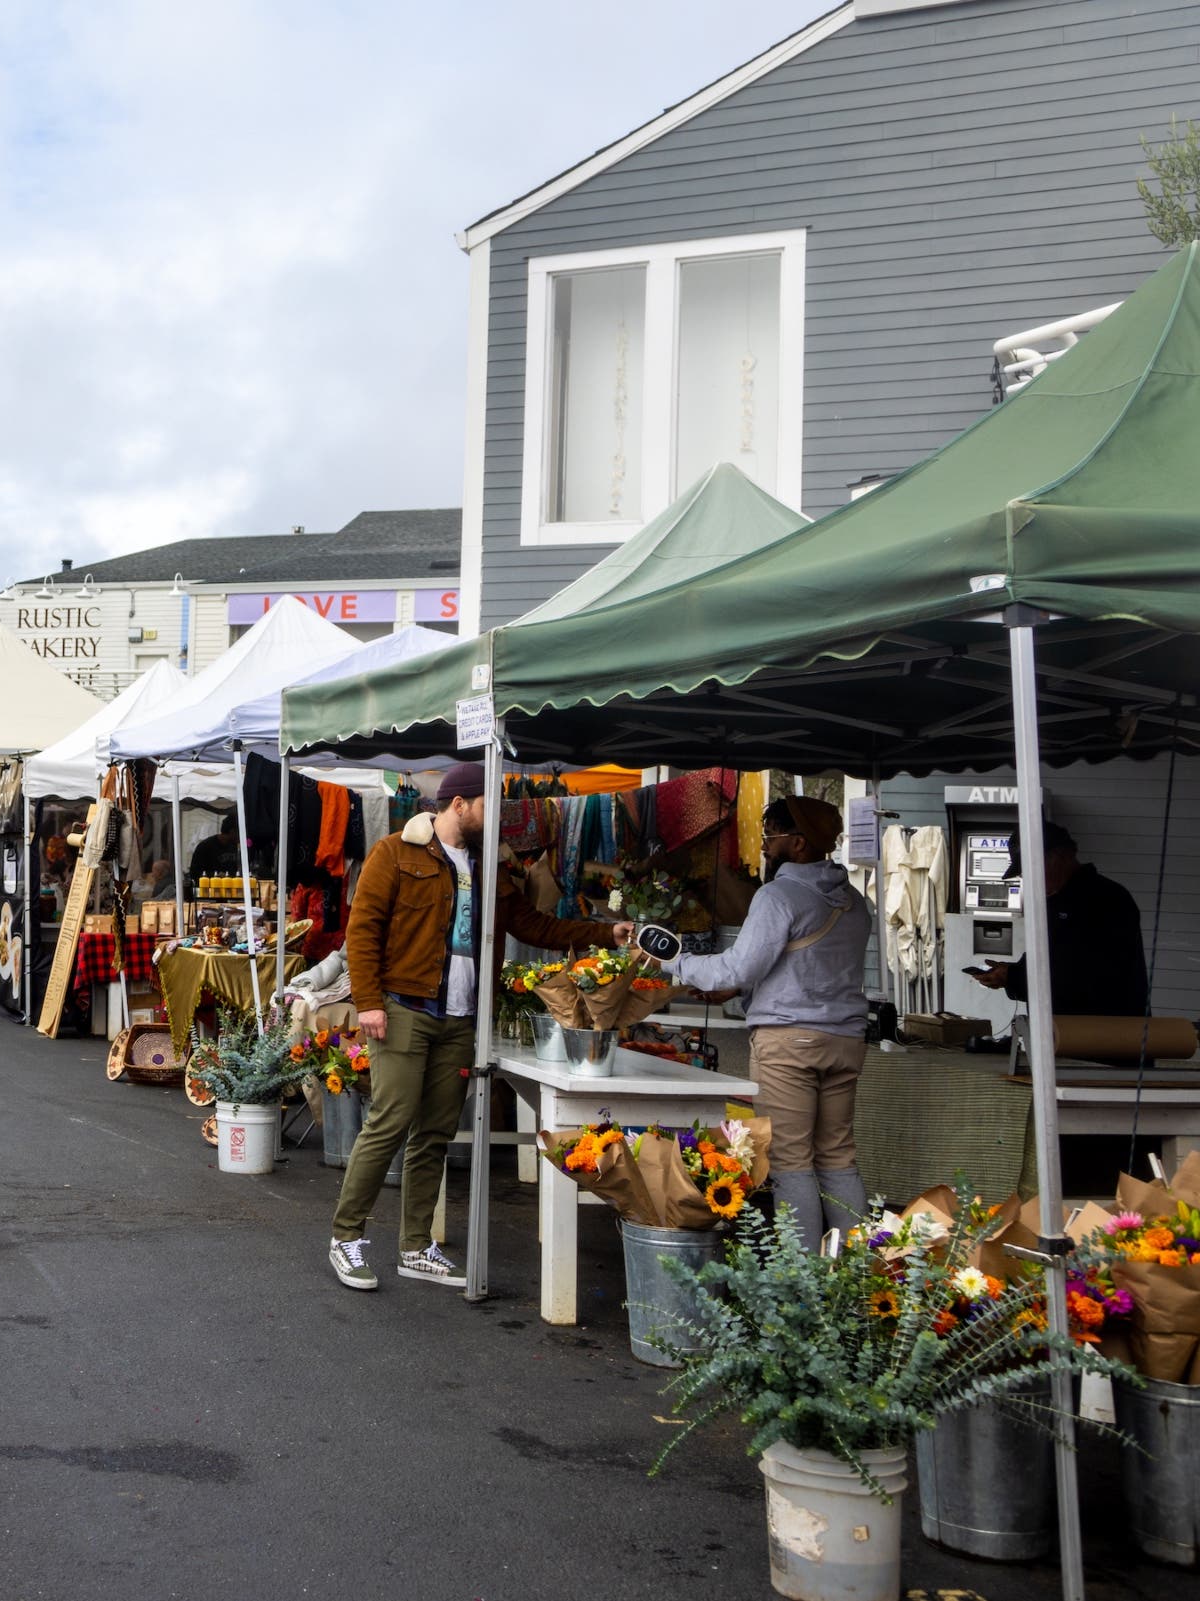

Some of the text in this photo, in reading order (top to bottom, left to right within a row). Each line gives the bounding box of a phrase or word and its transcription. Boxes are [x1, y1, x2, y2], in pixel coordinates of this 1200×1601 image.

[263, 594, 358, 619] LVE
[440, 592, 458, 618] S
[17, 606, 102, 629] RUSTIC
[21, 636, 102, 658] AKERY
[967, 786, 1019, 803] ATM
[981, 839, 1009, 847] ATM
